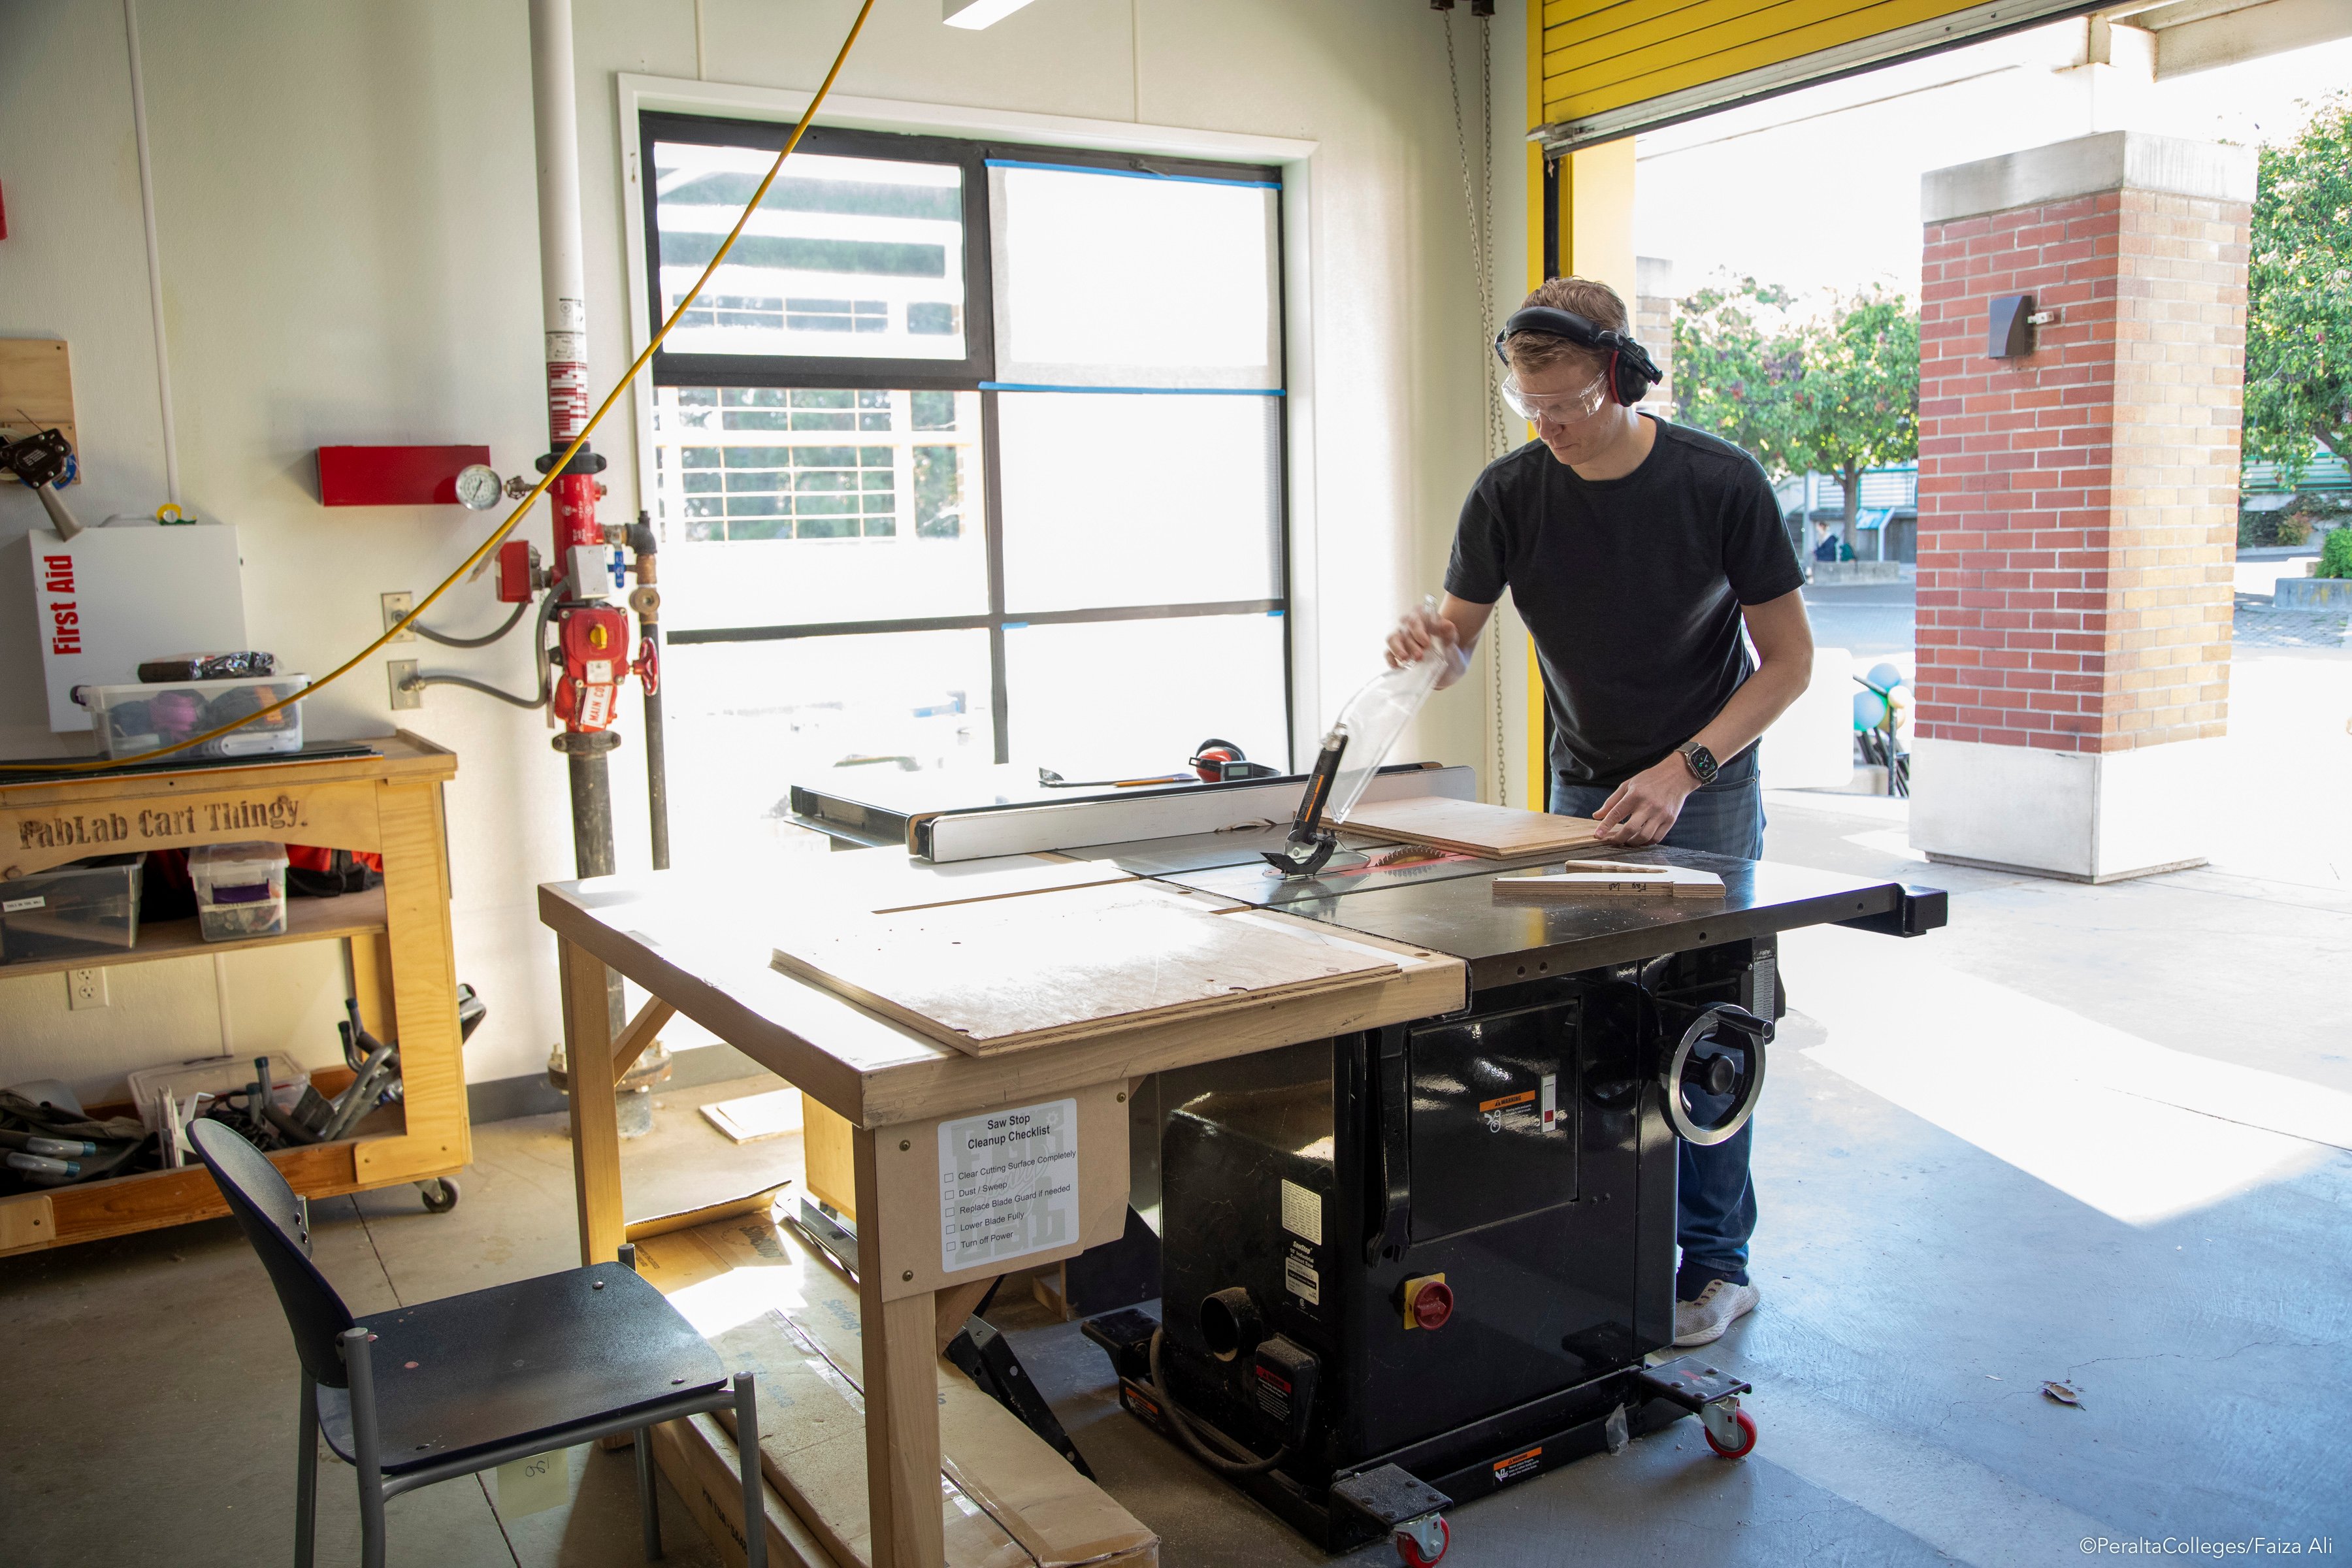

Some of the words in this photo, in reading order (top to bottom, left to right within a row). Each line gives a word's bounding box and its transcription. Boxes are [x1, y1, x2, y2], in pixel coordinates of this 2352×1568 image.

[44, 555, 75, 593] Aid
[50, 602, 82, 655] First
[589, 700, 601, 721] MAIN
[19, 813, 128, 849] FabLab
[139, 806, 196, 838] Cart
[1501, 1095, 1521, 1104] WARNING
[988, 1119, 1006, 1130] Saw
[1009, 1115, 1030, 1125] Stop
[968, 1134, 1006, 1149] Cleanup
[1009, 1125, 1050, 1141] Checklist
[958, 1171, 978, 1180] Clear
[980, 1164, 1006, 1175] Cutting
[1008, 1159, 1035, 1170] Surface
[1037, 1150, 1076, 1164] Completely
[959, 1188, 976, 1197] Dust
[983, 1183, 1007, 1192] Sweep
[960, 1202, 990, 1214] Replace
[992, 1197, 1013, 1207] Blade
[1015, 1192, 1036, 1202] Guard
[1045, 1184, 1070, 1196] needed
[960, 1221, 983, 1232] Lower
[985, 1215, 1005, 1226] Blade
[1007, 1211, 1024, 1221] Fully
[990, 1231, 1013, 1242] Power
[1296, 1250, 1314, 1264] Industrial
